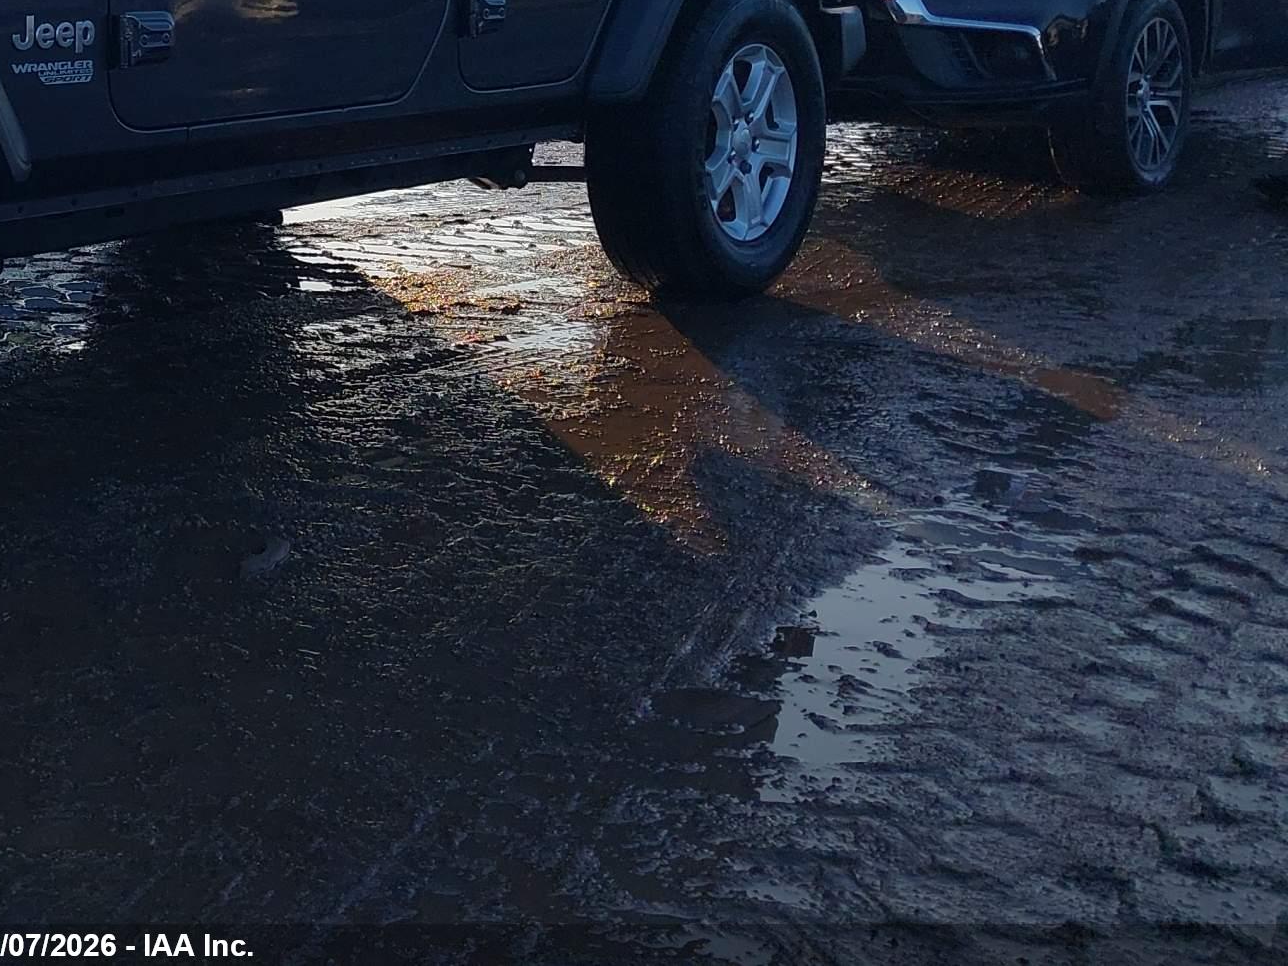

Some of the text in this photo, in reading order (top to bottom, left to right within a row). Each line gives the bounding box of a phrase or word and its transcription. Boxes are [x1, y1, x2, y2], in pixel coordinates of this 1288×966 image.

[11, 14, 96, 54] Jeep
[10, 60, 94, 74] WRANGLER
[39, 68, 94, 76] UNLIMITED
